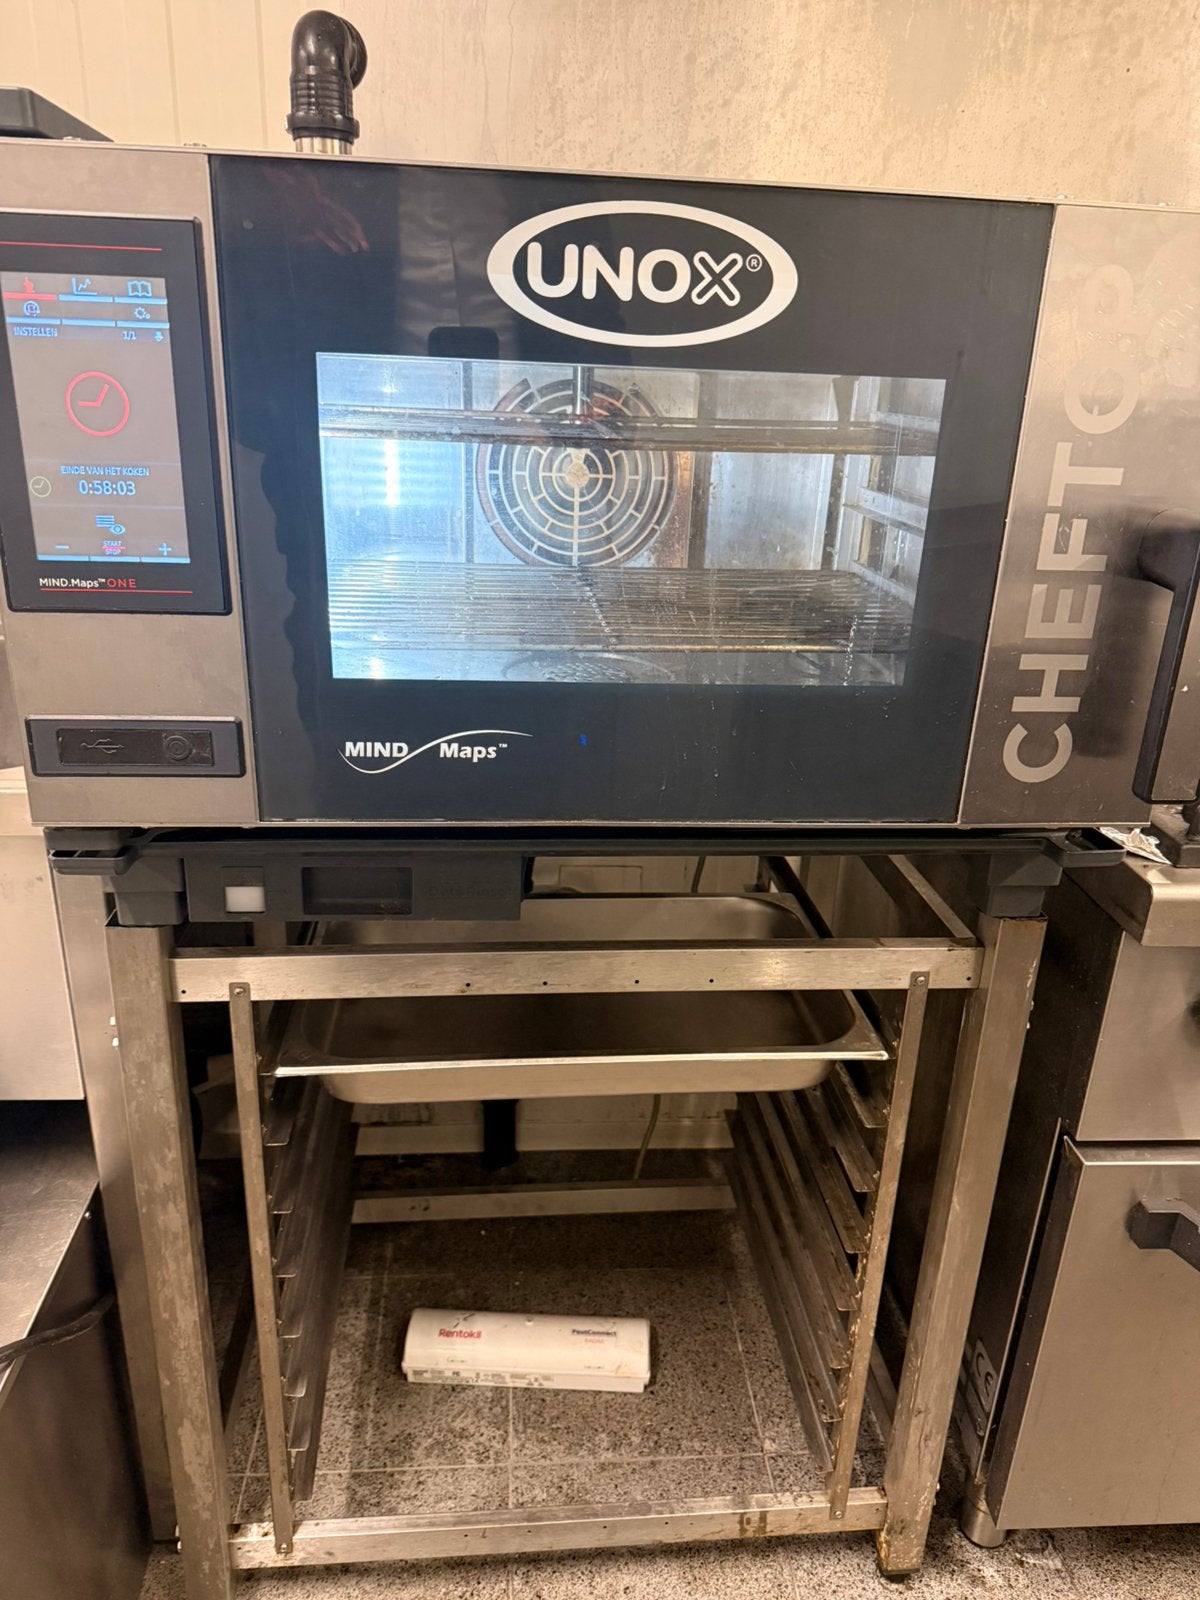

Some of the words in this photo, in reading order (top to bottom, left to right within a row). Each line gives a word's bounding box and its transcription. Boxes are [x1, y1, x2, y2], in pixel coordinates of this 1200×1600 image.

[13, 327, 58, 337] INSTELLEN
[122, 331, 137, 340] 1/1
[60, 465, 85, 475] EINDE
[86, 466, 104, 475] VAN
[105, 467, 121, 475] HET
[122, 467, 150, 477] KOKEN
[79, 480, 136, 496] 0:58:03
[1003, 264, 1140, 784] CHEFTOP
[345, 741, 409, 758] MIND
[438, 1327, 482, 1339] Rentokil
